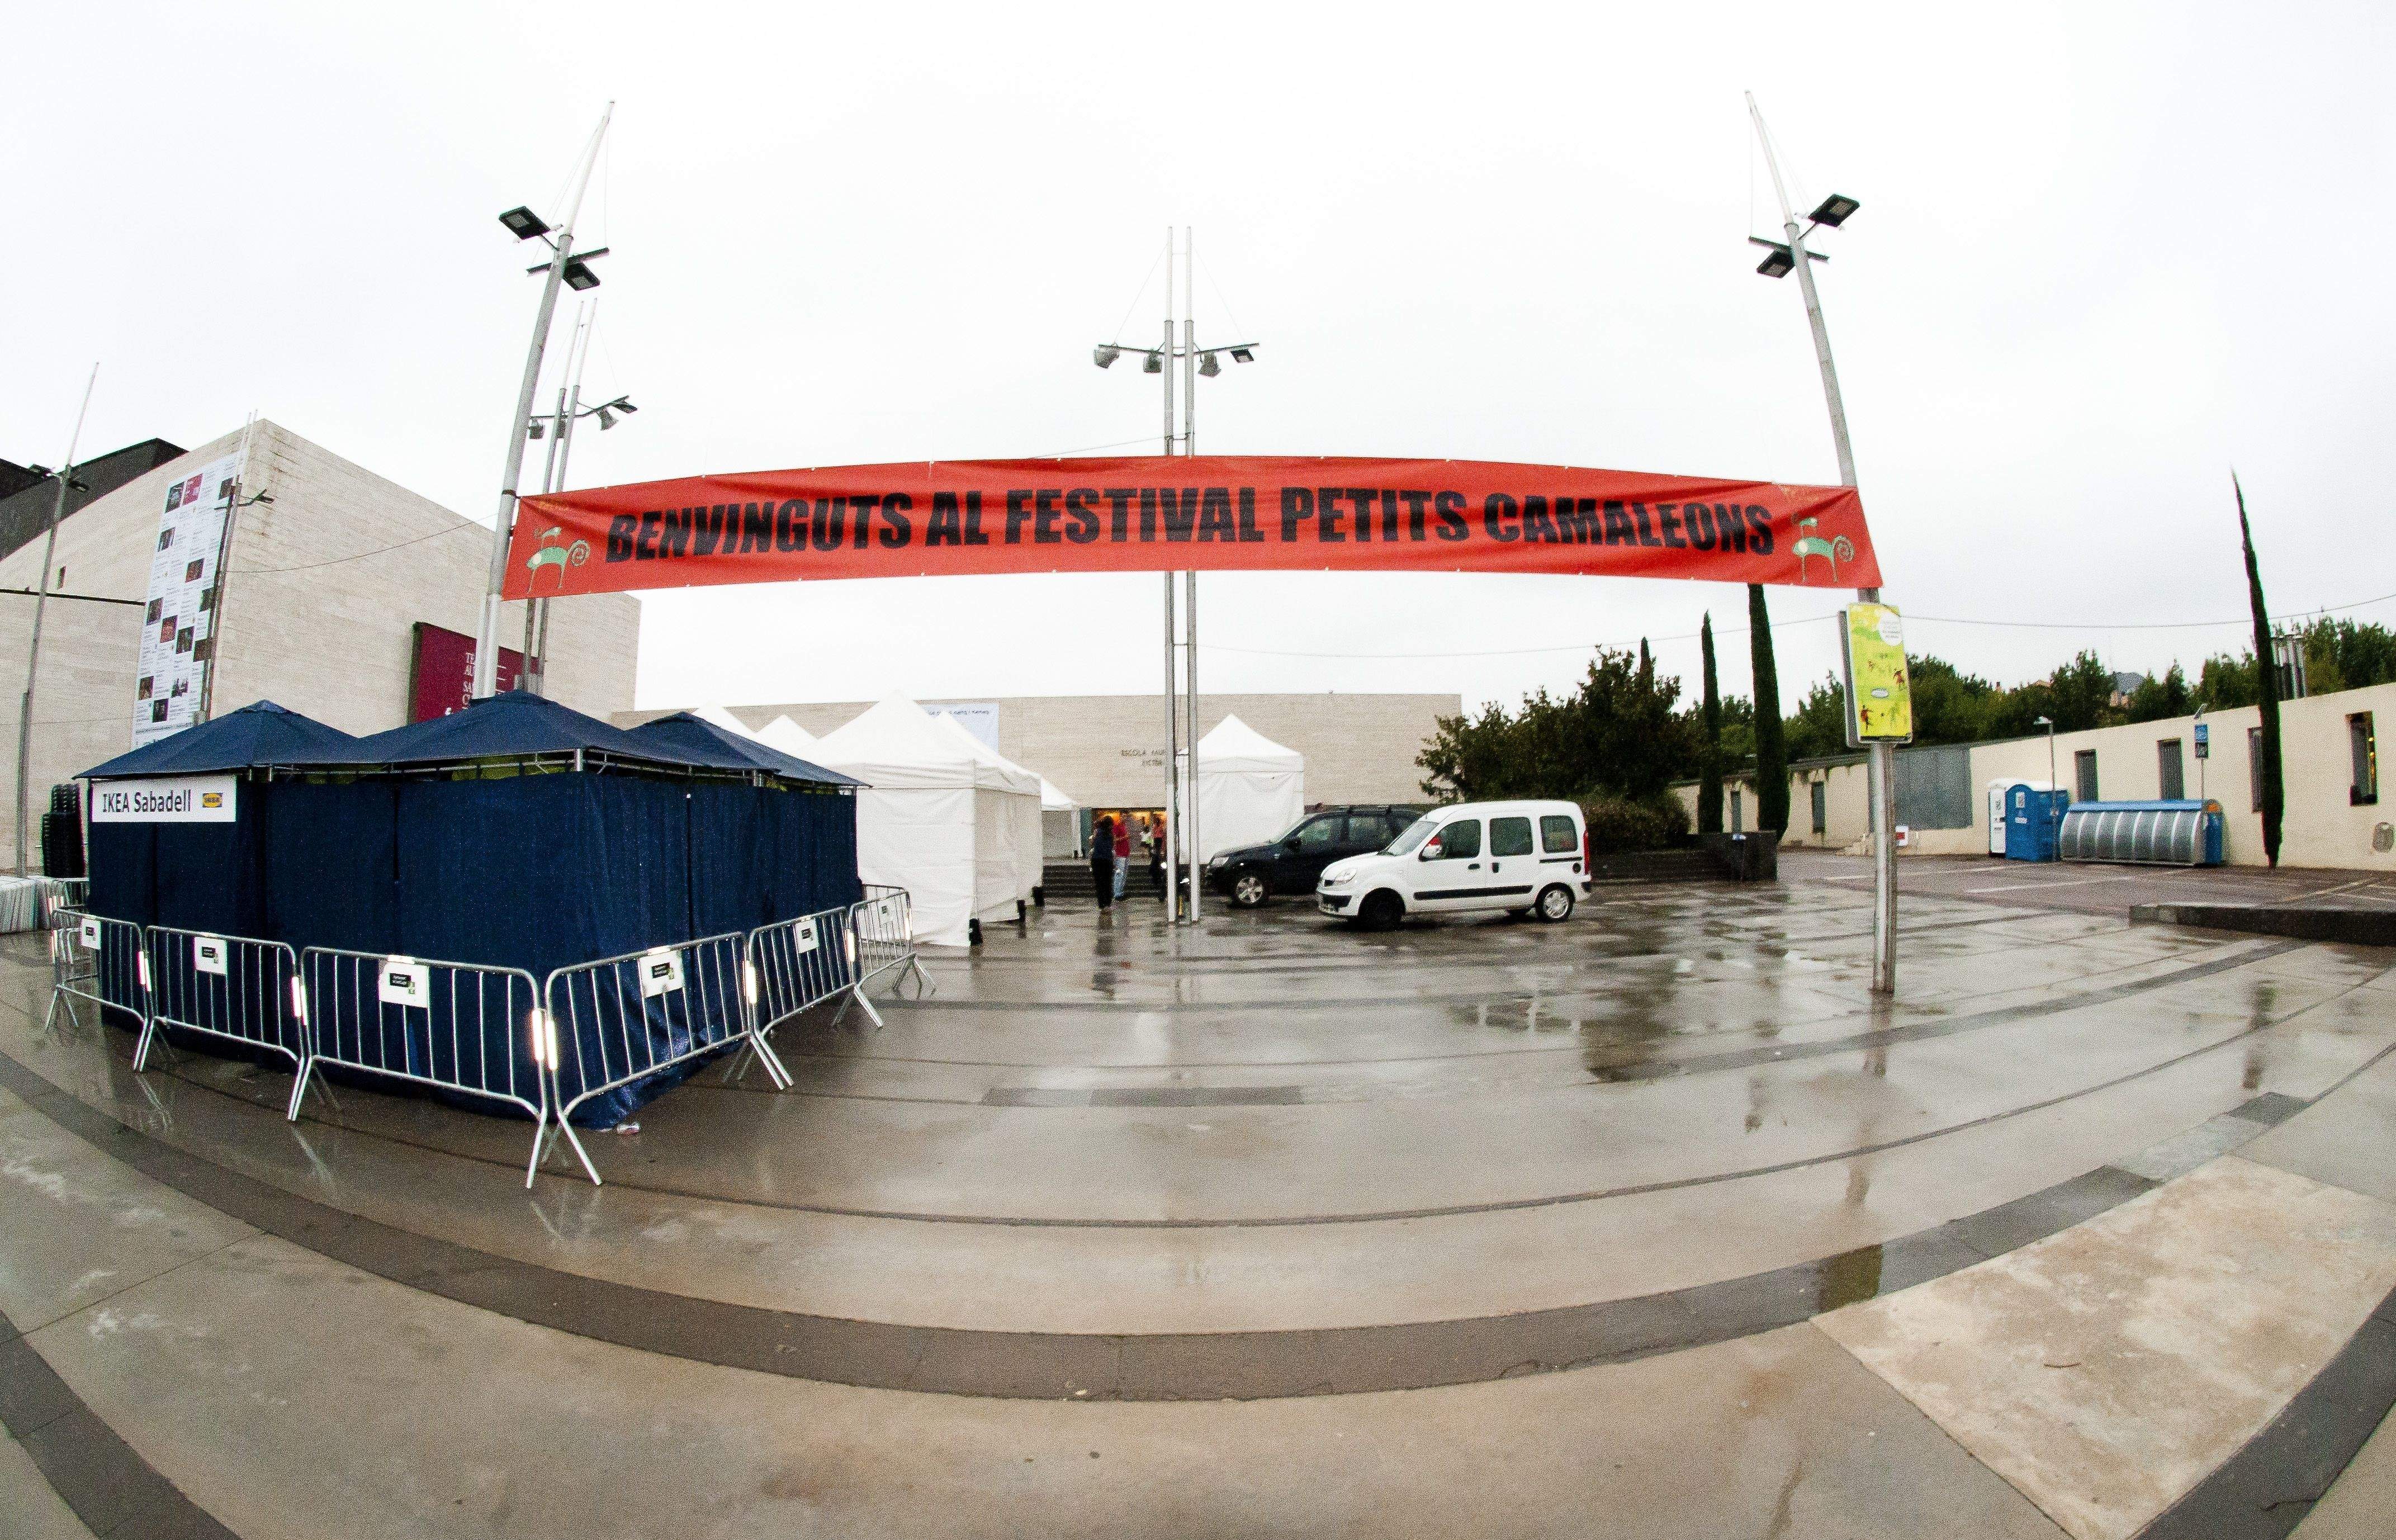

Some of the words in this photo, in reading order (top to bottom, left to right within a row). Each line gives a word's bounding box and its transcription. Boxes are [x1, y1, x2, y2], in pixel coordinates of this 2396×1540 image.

[606, 491, 913, 562] BENVINGUTS
[925, 490, 989, 546] AL
[1005, 487, 1264, 544] FESTIVAL
[1280, 487, 1470, 542] PETITS
[1483, 492, 1774, 556] CAMALEONS
[103, 792, 130, 813] IKEA
[134, 789, 191, 812] Sabadell
